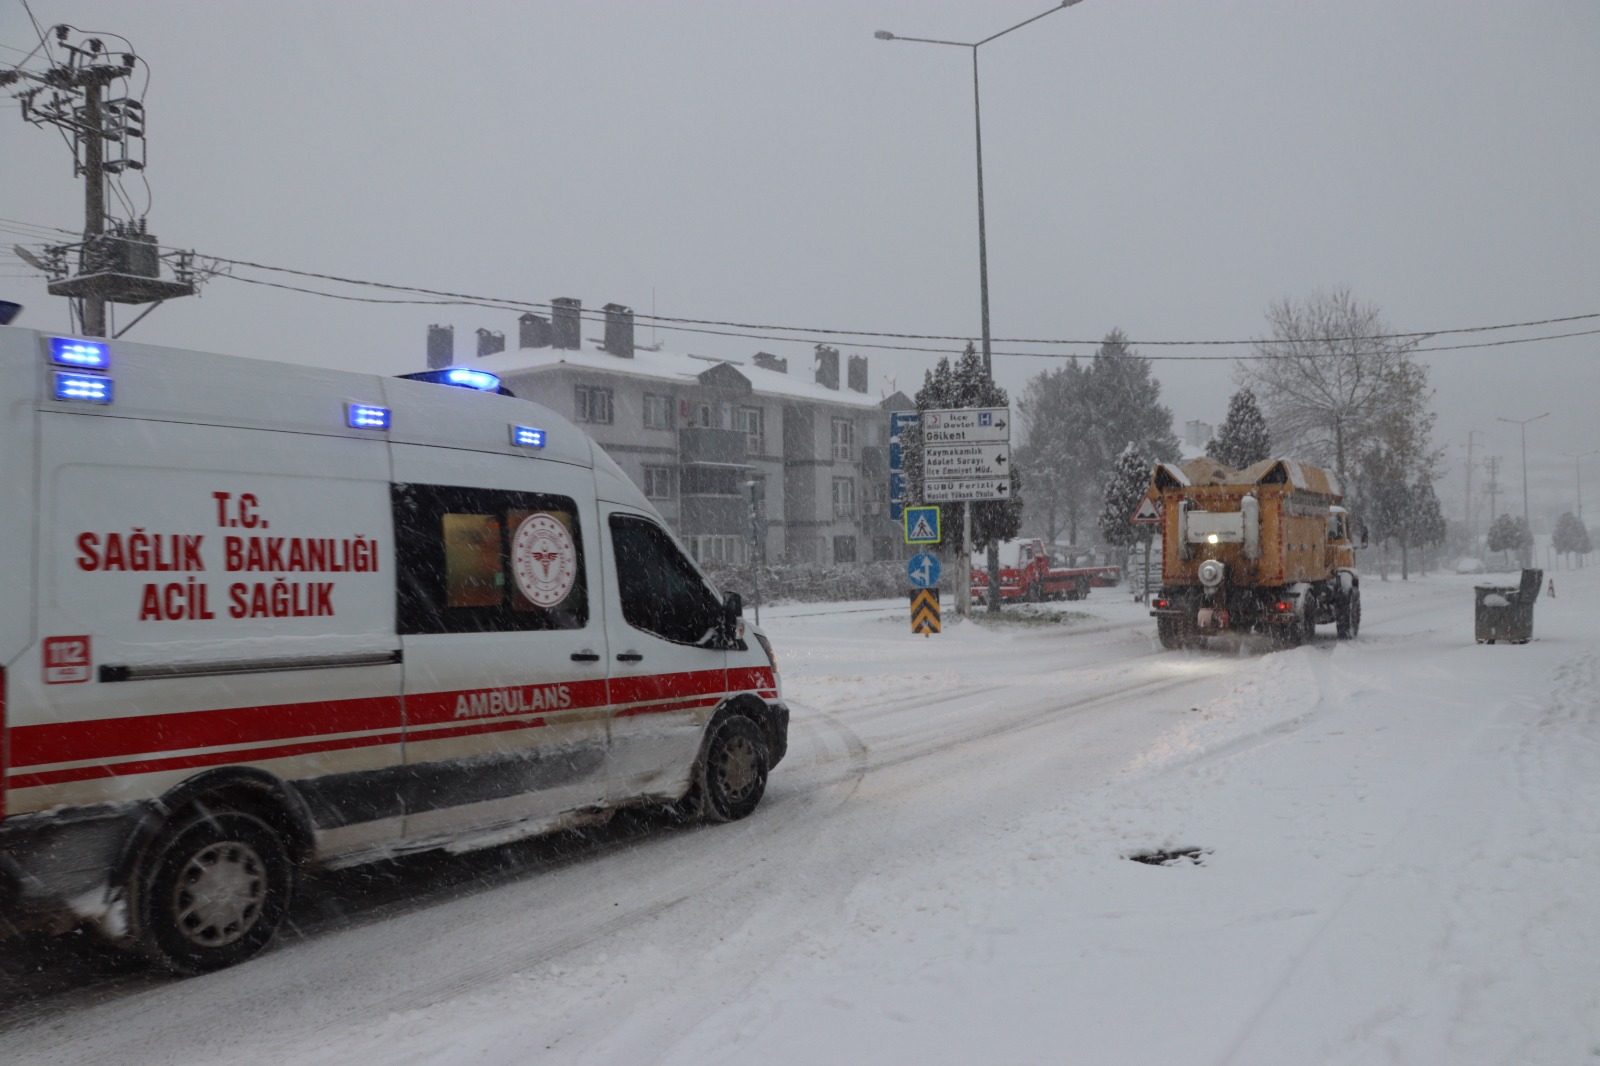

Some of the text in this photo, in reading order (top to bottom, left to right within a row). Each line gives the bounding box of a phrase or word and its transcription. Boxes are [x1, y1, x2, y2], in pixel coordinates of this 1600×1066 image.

[926, 431, 966, 440] Gölkent
[926, 447, 983, 457] Kaymakamlık
[927, 457, 984, 466] Adalet Sarayı
[942, 467, 973, 475] Emniyet
[975, 466, 993, 474] Müd.
[959, 481, 994, 490] Ferizli
[212, 491, 269, 529] T.C.
[76, 528, 379, 573] SAĞLIK BAKANLIĞI
[138, 577, 335, 621] ACİL SAĞLIK
[47, 641, 86, 664] 112
[454, 686, 571, 719] AMBULANS
